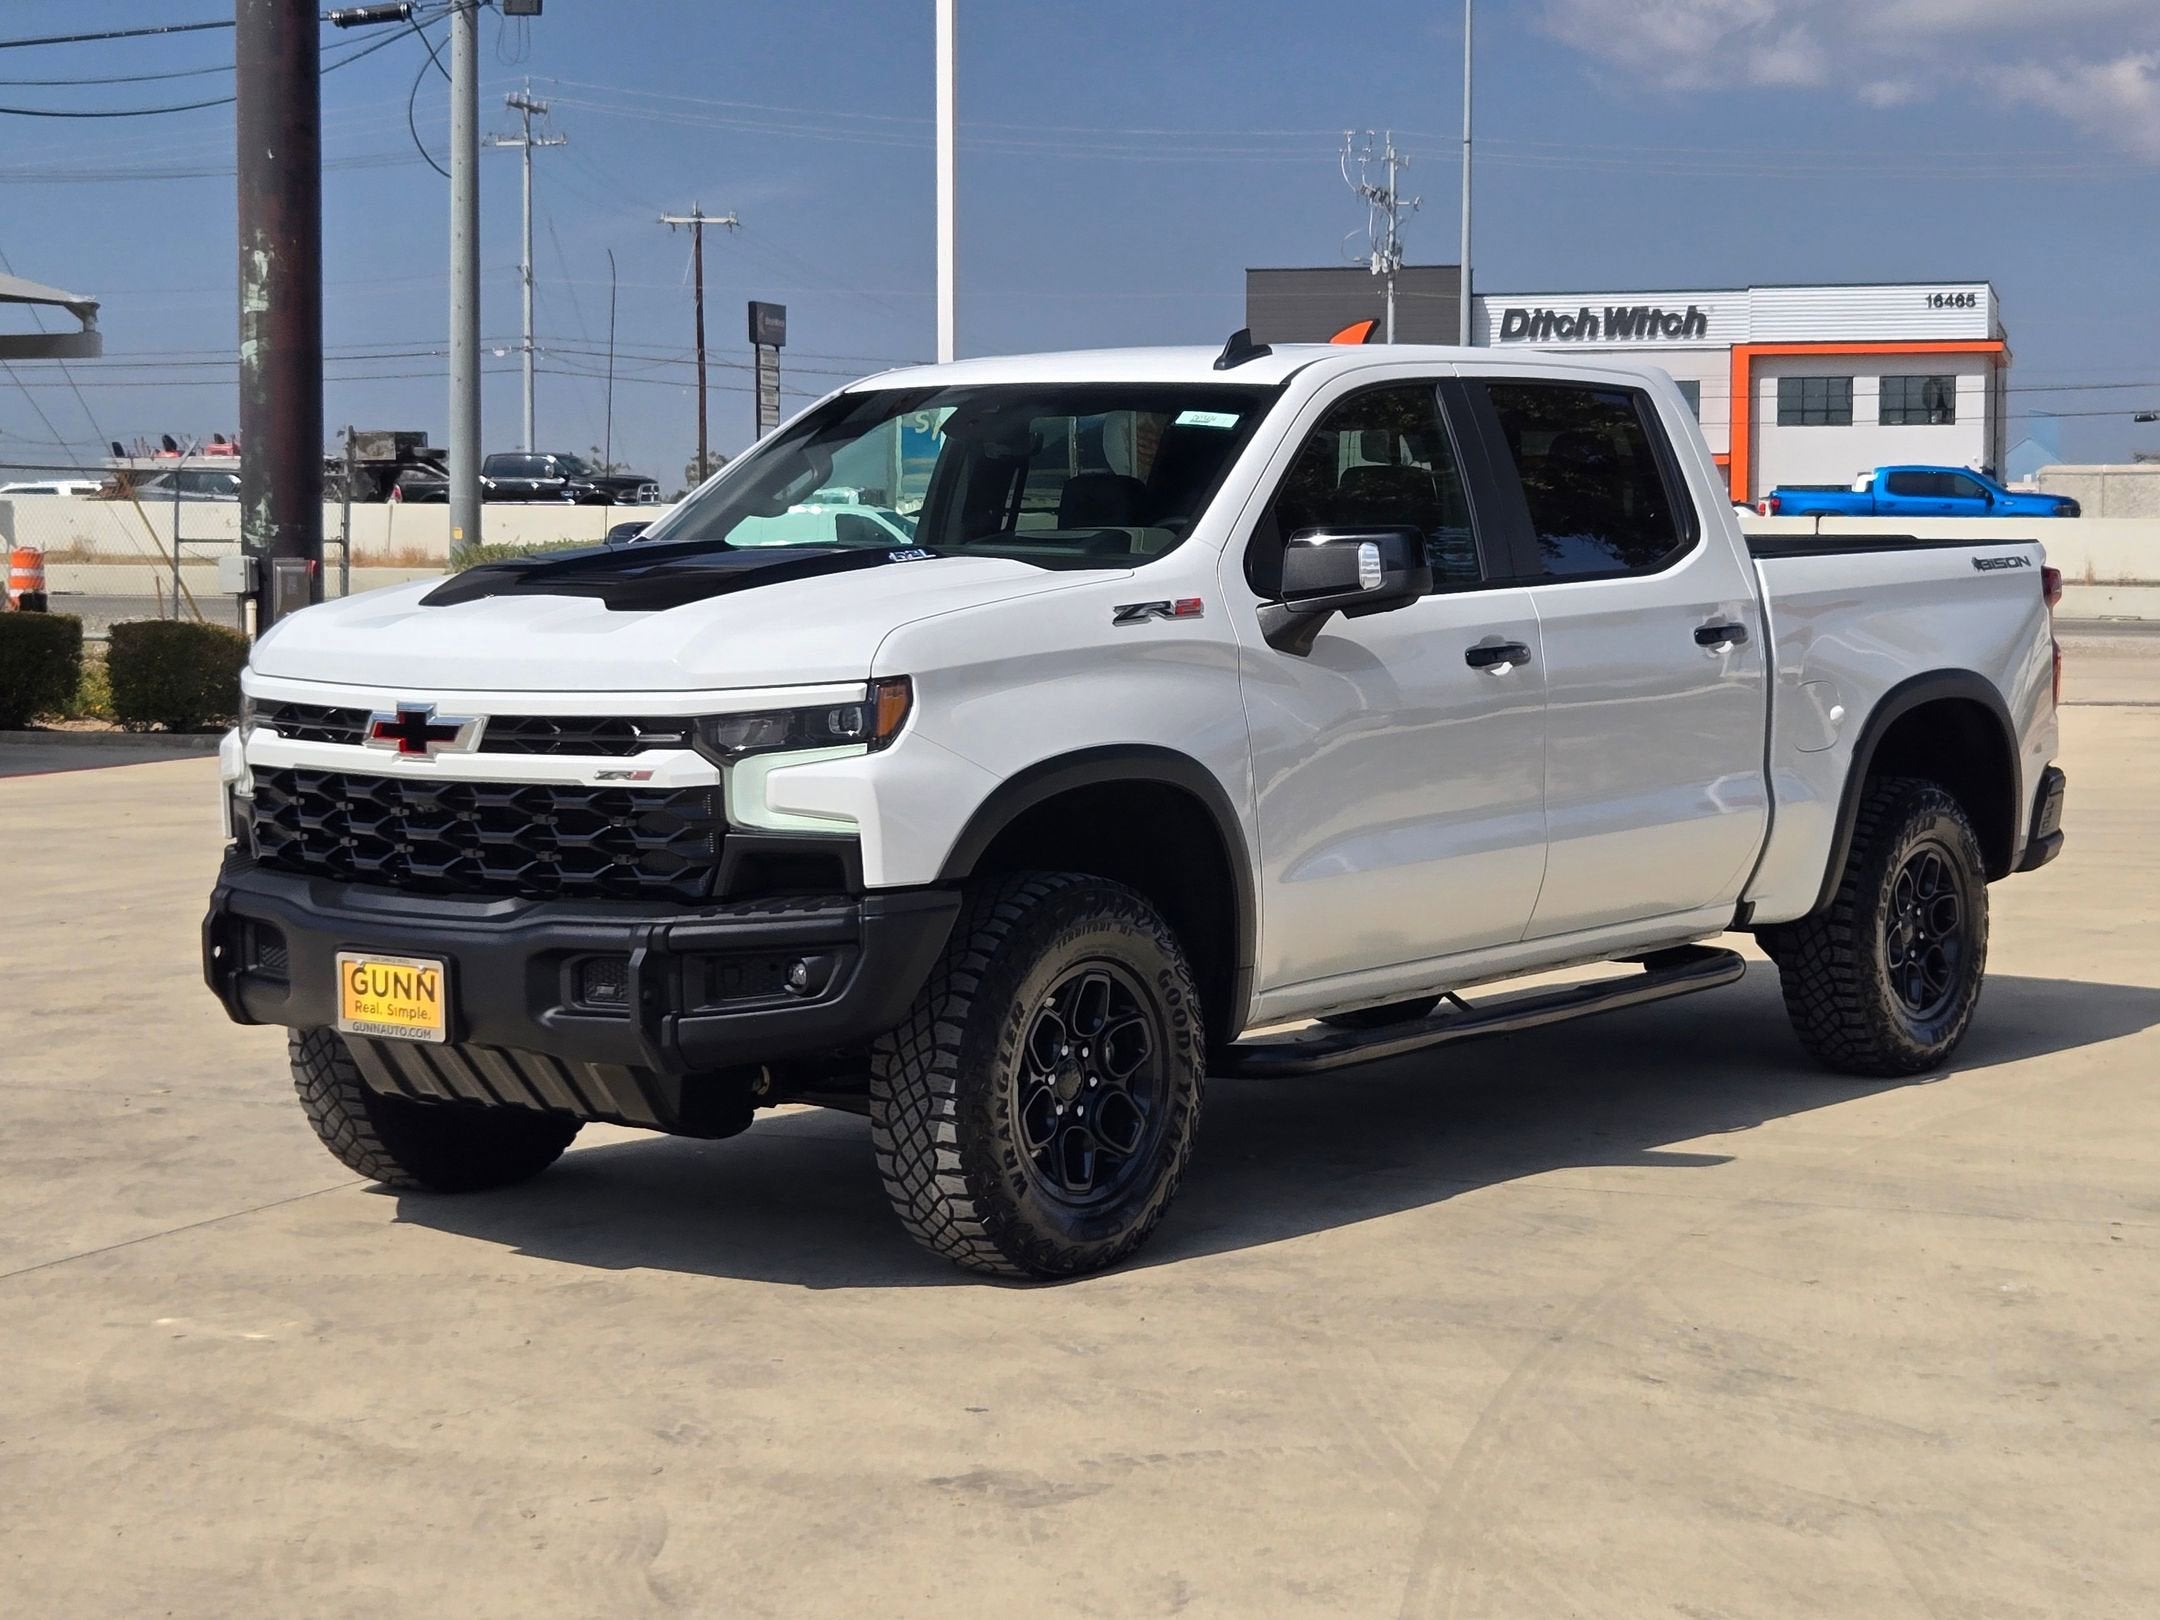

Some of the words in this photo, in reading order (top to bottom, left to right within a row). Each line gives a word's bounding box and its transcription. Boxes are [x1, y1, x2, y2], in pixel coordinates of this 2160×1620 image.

[1926, 293, 1976, 309] 16465
[1500, 308, 1599, 341] Ditch
[1603, 305, 1708, 341] Witch
[1977, 556, 2032, 571] BISON
[350, 967, 436, 1003] GUNN
[354, 1000, 383, 1015] Real.
[387, 1003, 432, 1021] Simple.
[352, 1021, 432, 1040] GUNNAUTO.COM
[1157, 968, 1193, 1162] GOODYEAR
[997, 1001, 1028, 1198] WRANGLER
